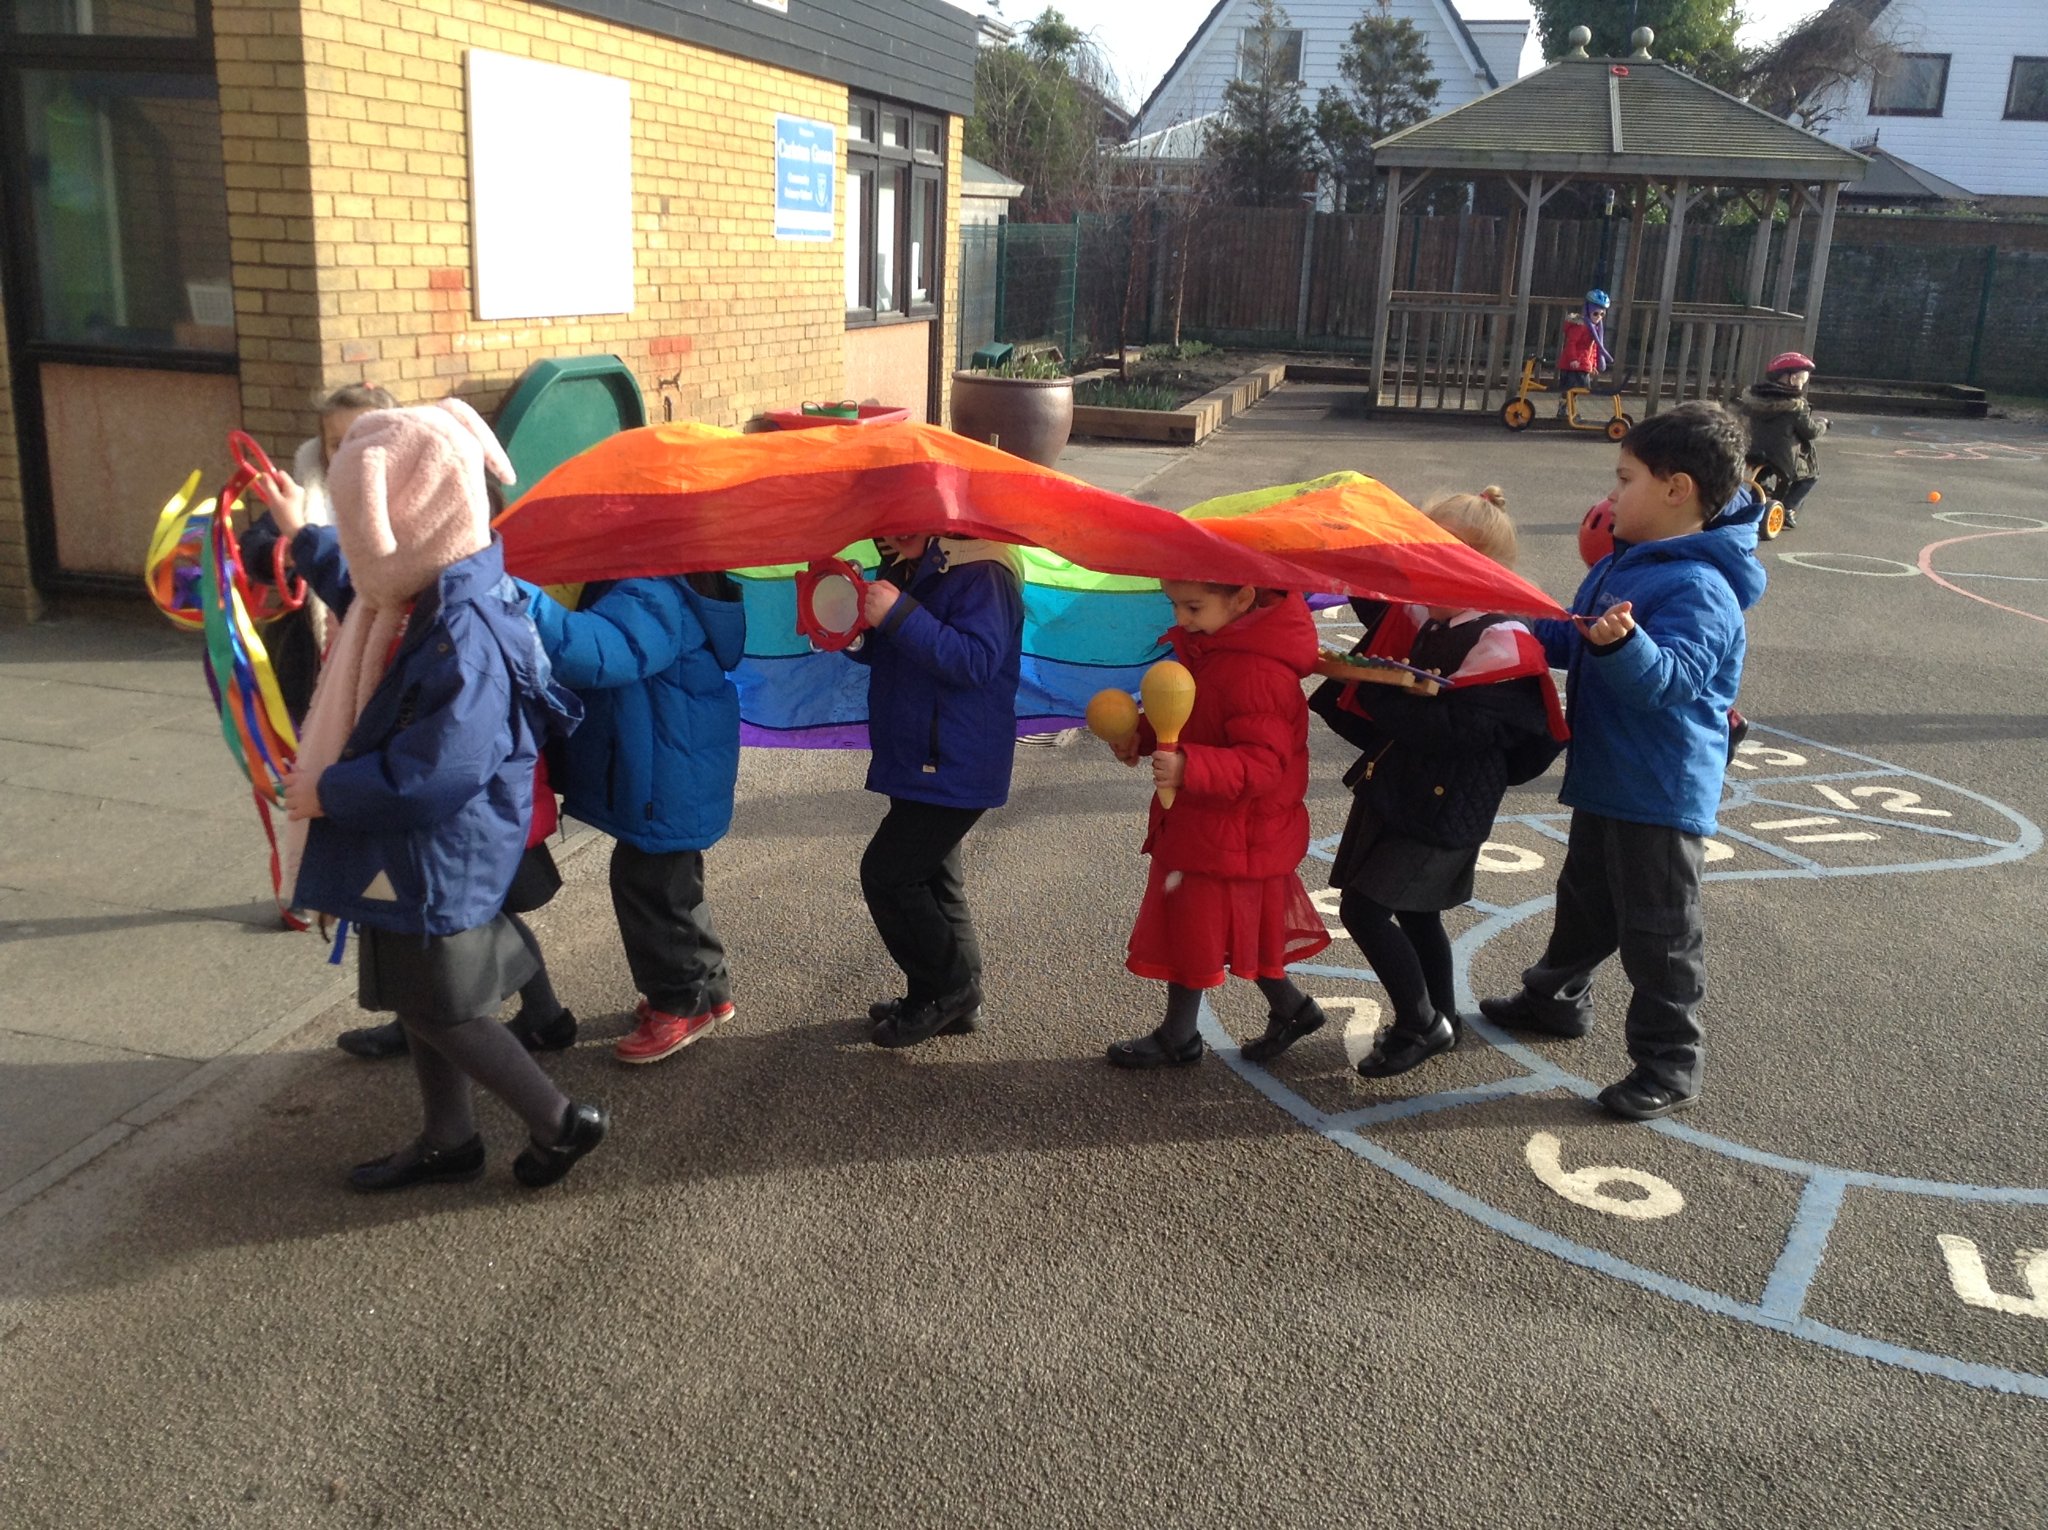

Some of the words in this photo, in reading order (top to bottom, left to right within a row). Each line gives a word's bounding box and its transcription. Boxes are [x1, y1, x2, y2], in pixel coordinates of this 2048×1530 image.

[1811, 784, 1953, 817] 12
[1750, 816, 1881, 843] 11
[1525, 1131, 1685, 1220] 6
